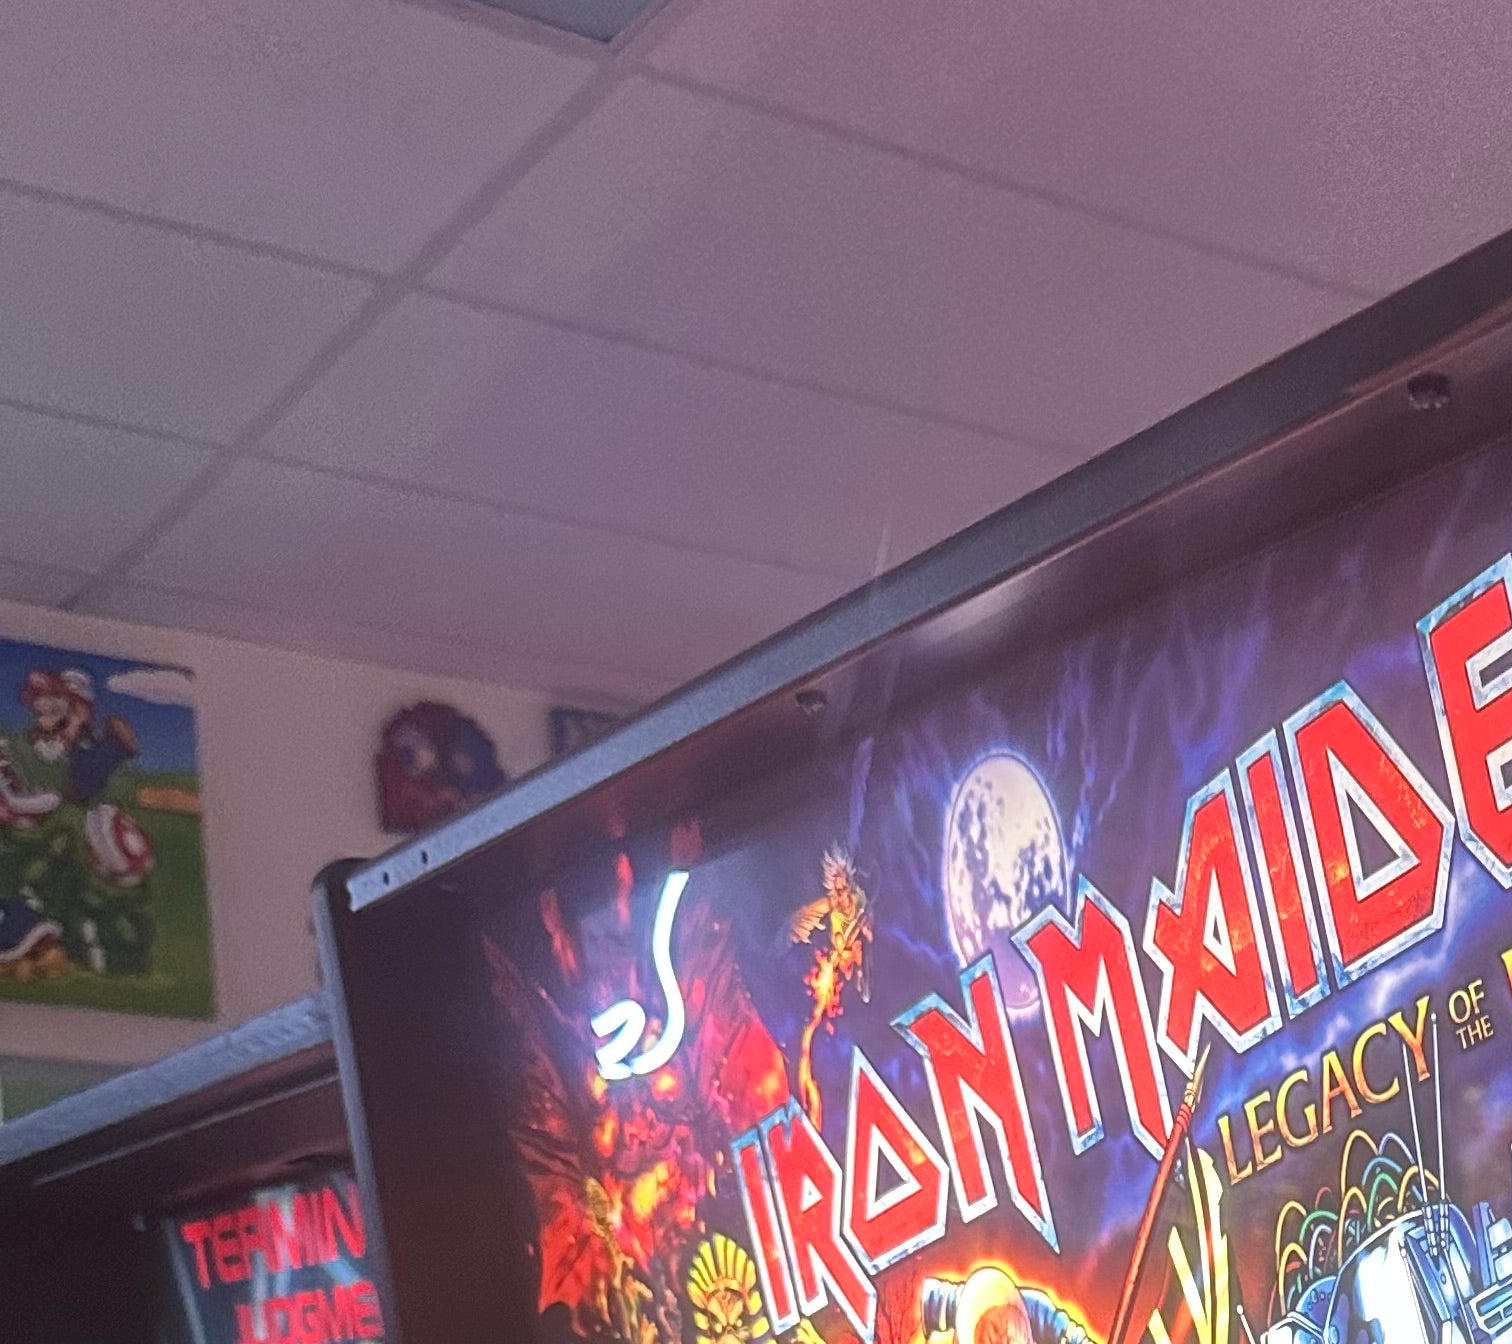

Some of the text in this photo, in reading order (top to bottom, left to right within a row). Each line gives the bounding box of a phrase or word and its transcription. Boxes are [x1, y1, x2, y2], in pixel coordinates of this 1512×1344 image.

[1217, 978, 1485, 1185] LEGACY OF
[1456, 1018, 1494, 1051] THE
